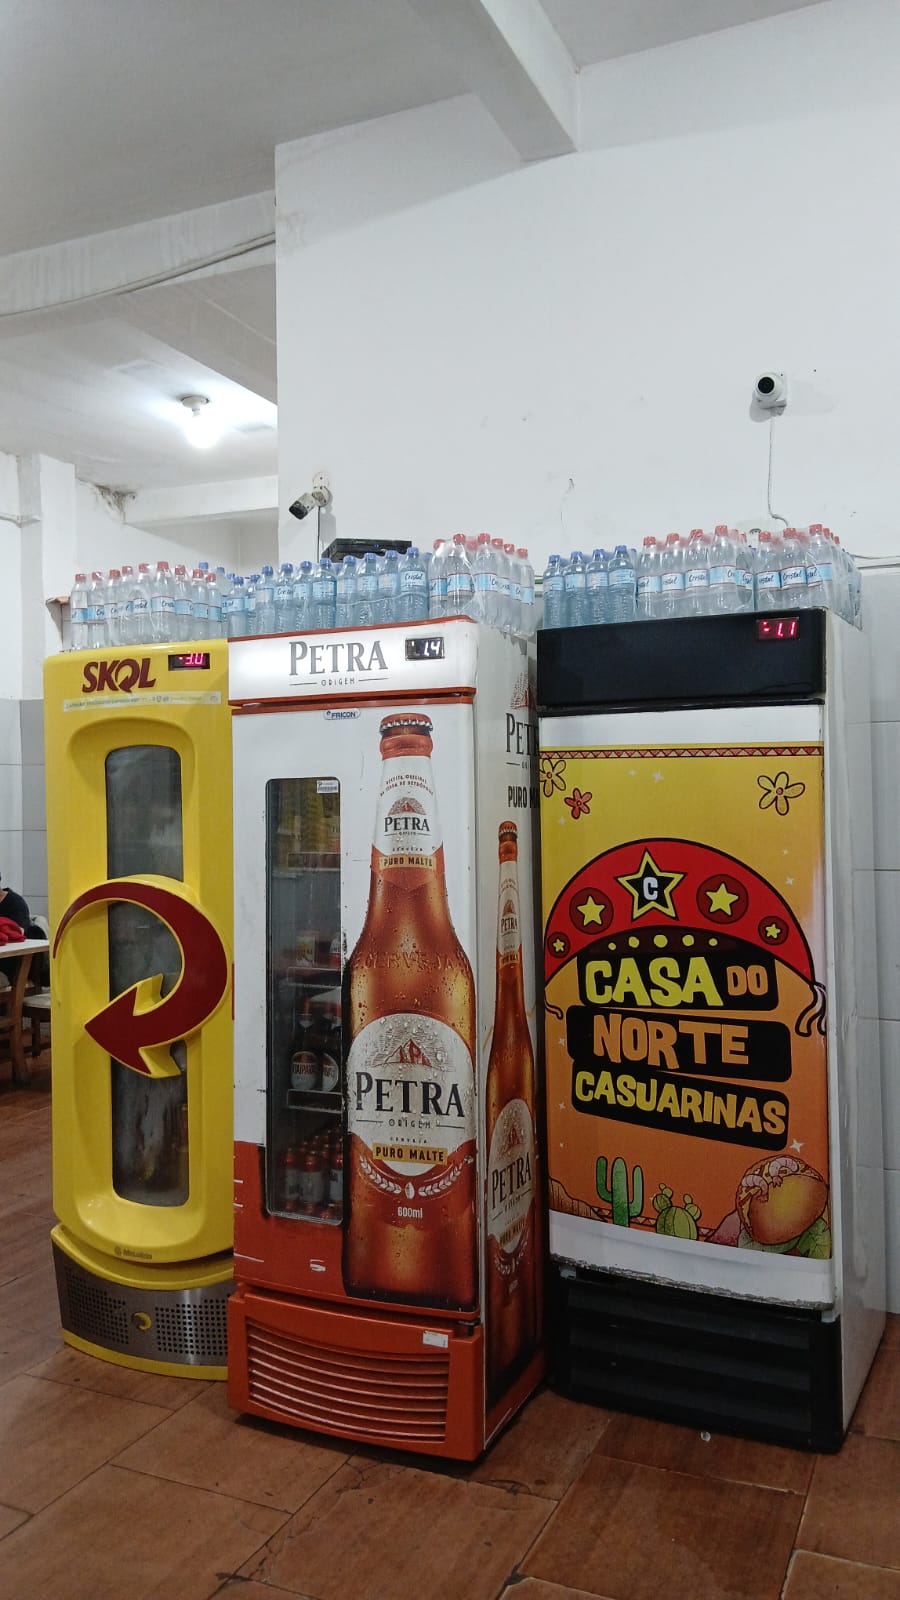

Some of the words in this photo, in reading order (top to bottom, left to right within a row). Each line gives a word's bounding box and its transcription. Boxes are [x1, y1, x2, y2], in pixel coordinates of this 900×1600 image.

[289, 640, 389, 676] PETRA
[82, 658, 156, 692] SKOL
[321, 677, 355, 687] ORIGEM
[331, 711, 356, 719] FRICON
[507, 786, 528, 808] PURO
[384, 816, 430, 833] PETRA
[383, 856, 405, 867] PURO
[408, 857, 433, 867] MALTE
[642, 876, 659, 901] C
[585, 956, 724, 1007] CASA
[726, 964, 769, 997] DO
[592, 1013, 749, 1070] NORTE
[355, 1071, 466, 1118] PETRA
[575, 1070, 787, 1135] CASUARINAS
[388, 1118, 431, 1129] ORIGEM
[375, 1146, 404, 1159] PURO
[409, 1149, 444, 1163] MALTE
[492, 1151, 532, 1210] PETRA
